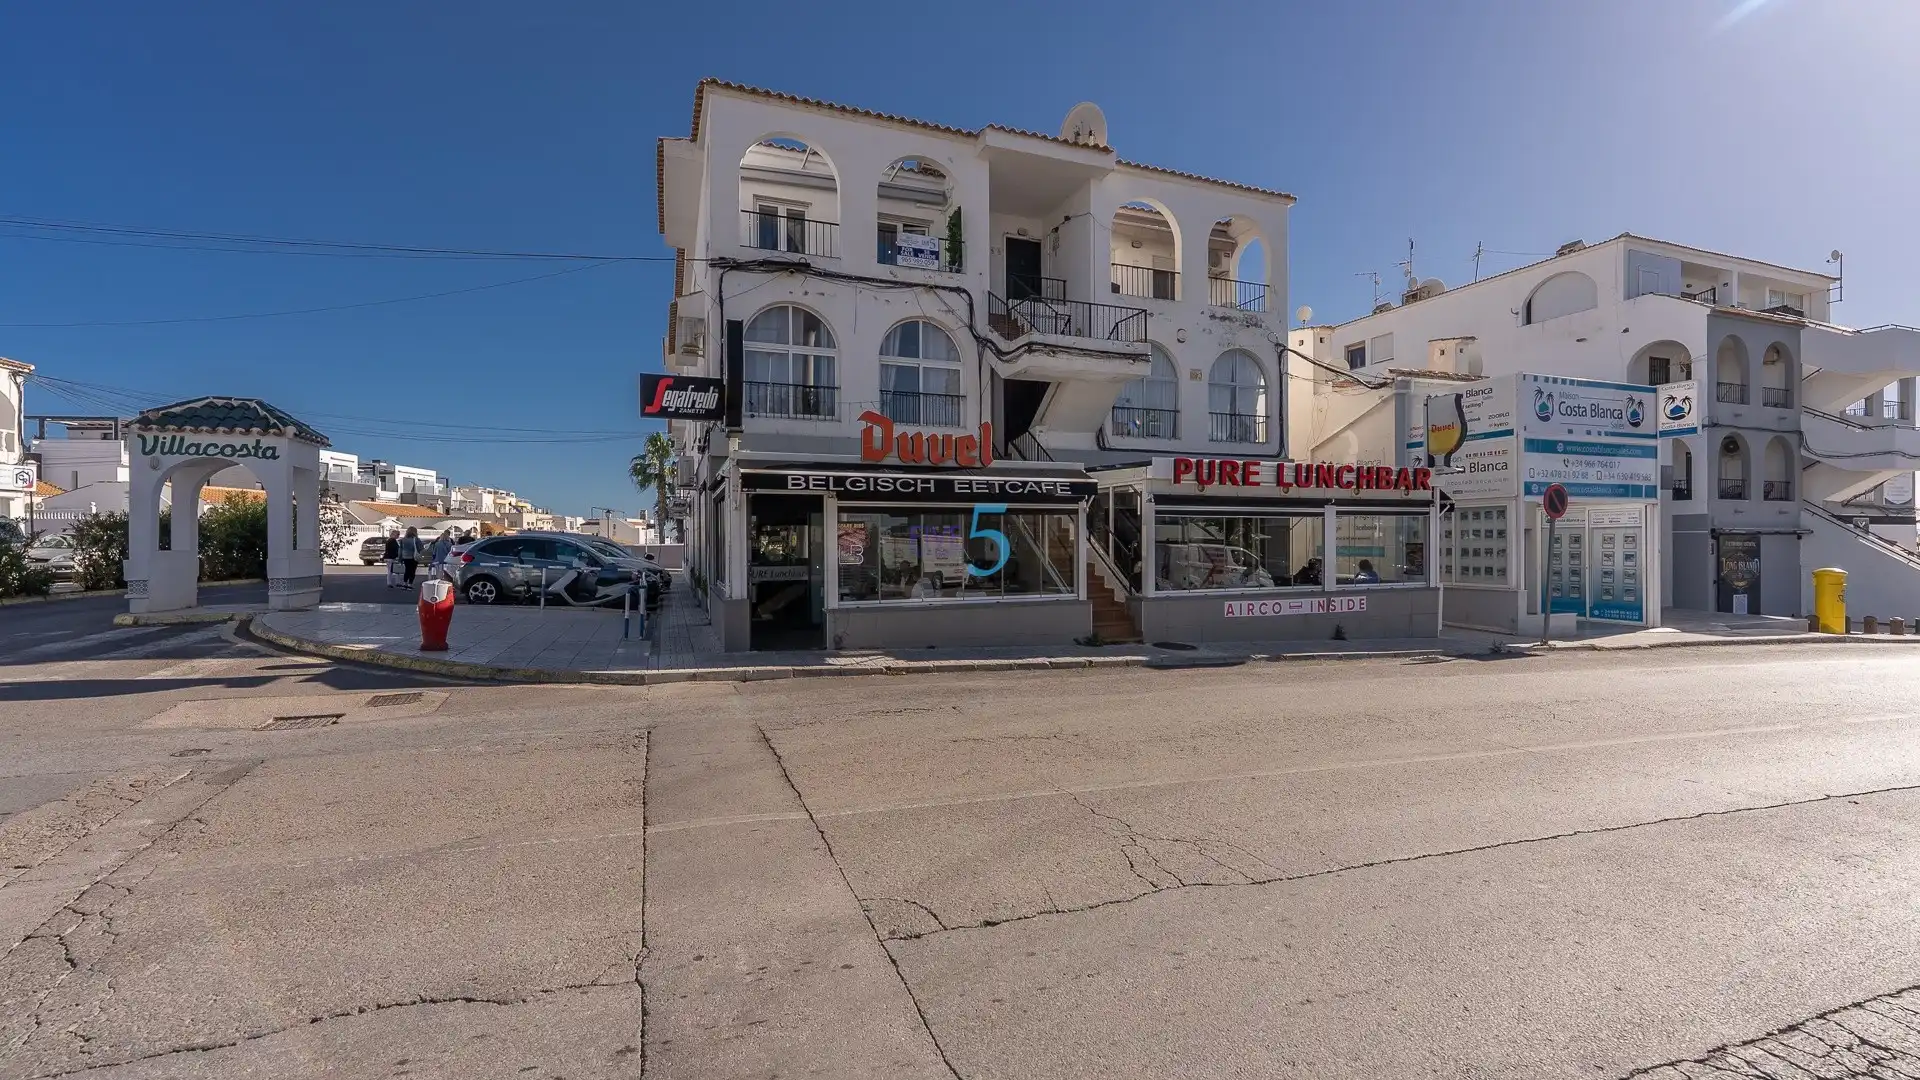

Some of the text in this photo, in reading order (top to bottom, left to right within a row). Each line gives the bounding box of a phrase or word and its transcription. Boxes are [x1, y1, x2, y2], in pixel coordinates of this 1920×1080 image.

[644, 378, 719, 413] Segafredo
[1465, 387, 1493, 399] Blanca
[1559, 391, 1580, 400] Maison
[1558, 401, 1623, 420] Costa Blanca
[1431, 422, 1455, 433] Duvel
[1610, 421, 1625, 430] Sales
[137, 433, 280, 460] Villacosta
[858, 410, 994, 468] Duvel
[1173, 457, 1432, 491] PURE LUNCHBAR
[1469, 461, 1508, 474] Blanca
[787, 475, 1072, 495] BELGISCH EETCAFE
[1225, 598, 1366, 616] AIRCO INSIDE
